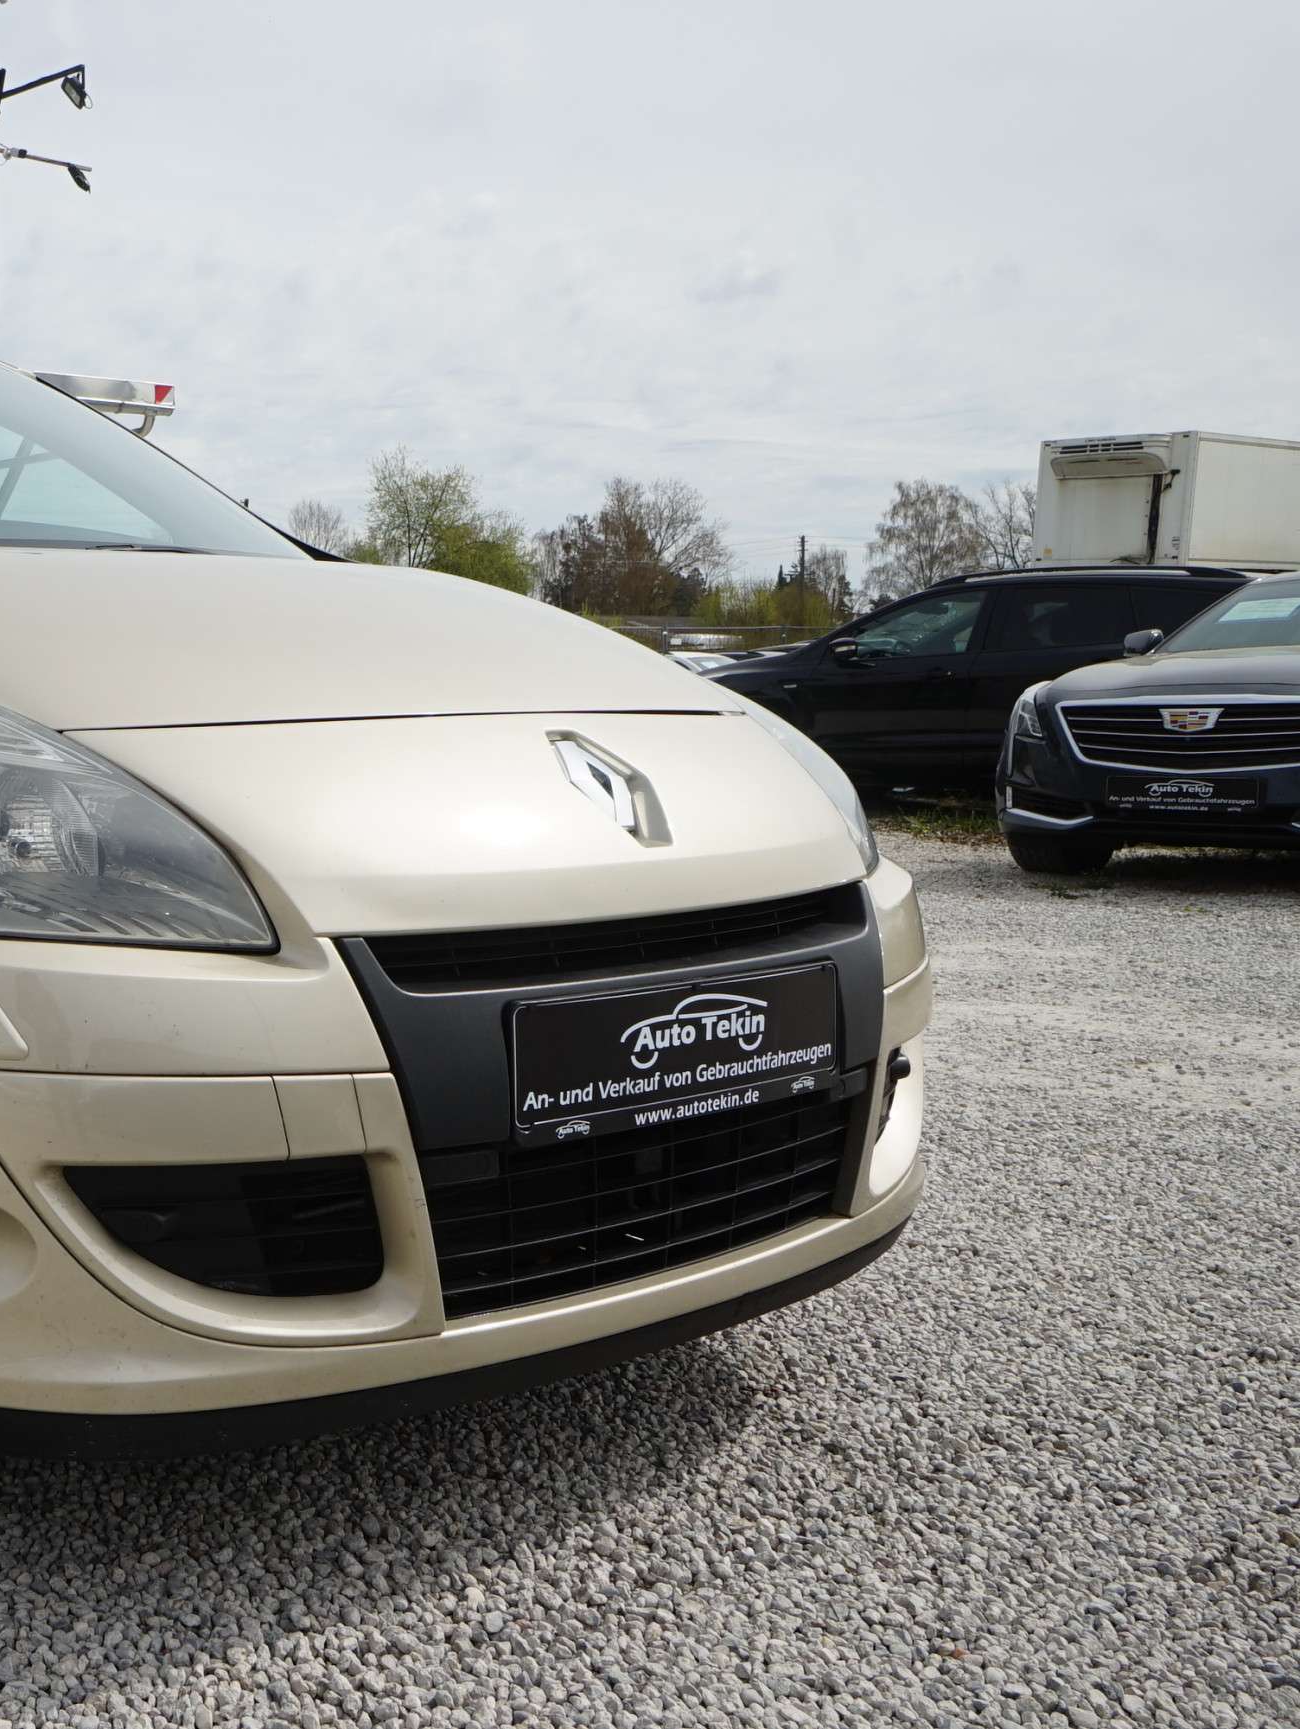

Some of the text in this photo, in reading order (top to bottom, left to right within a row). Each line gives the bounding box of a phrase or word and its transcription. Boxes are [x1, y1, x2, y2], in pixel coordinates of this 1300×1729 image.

[1151, 783, 1214, 793] Auto Tekin
[634, 1011, 766, 1053] Auto Tekin
[523, 1042, 832, 1111] An- und Verkauf von Gebrauchtfahrzeugen
[635, 1088, 760, 1126] www.autotekin.de
